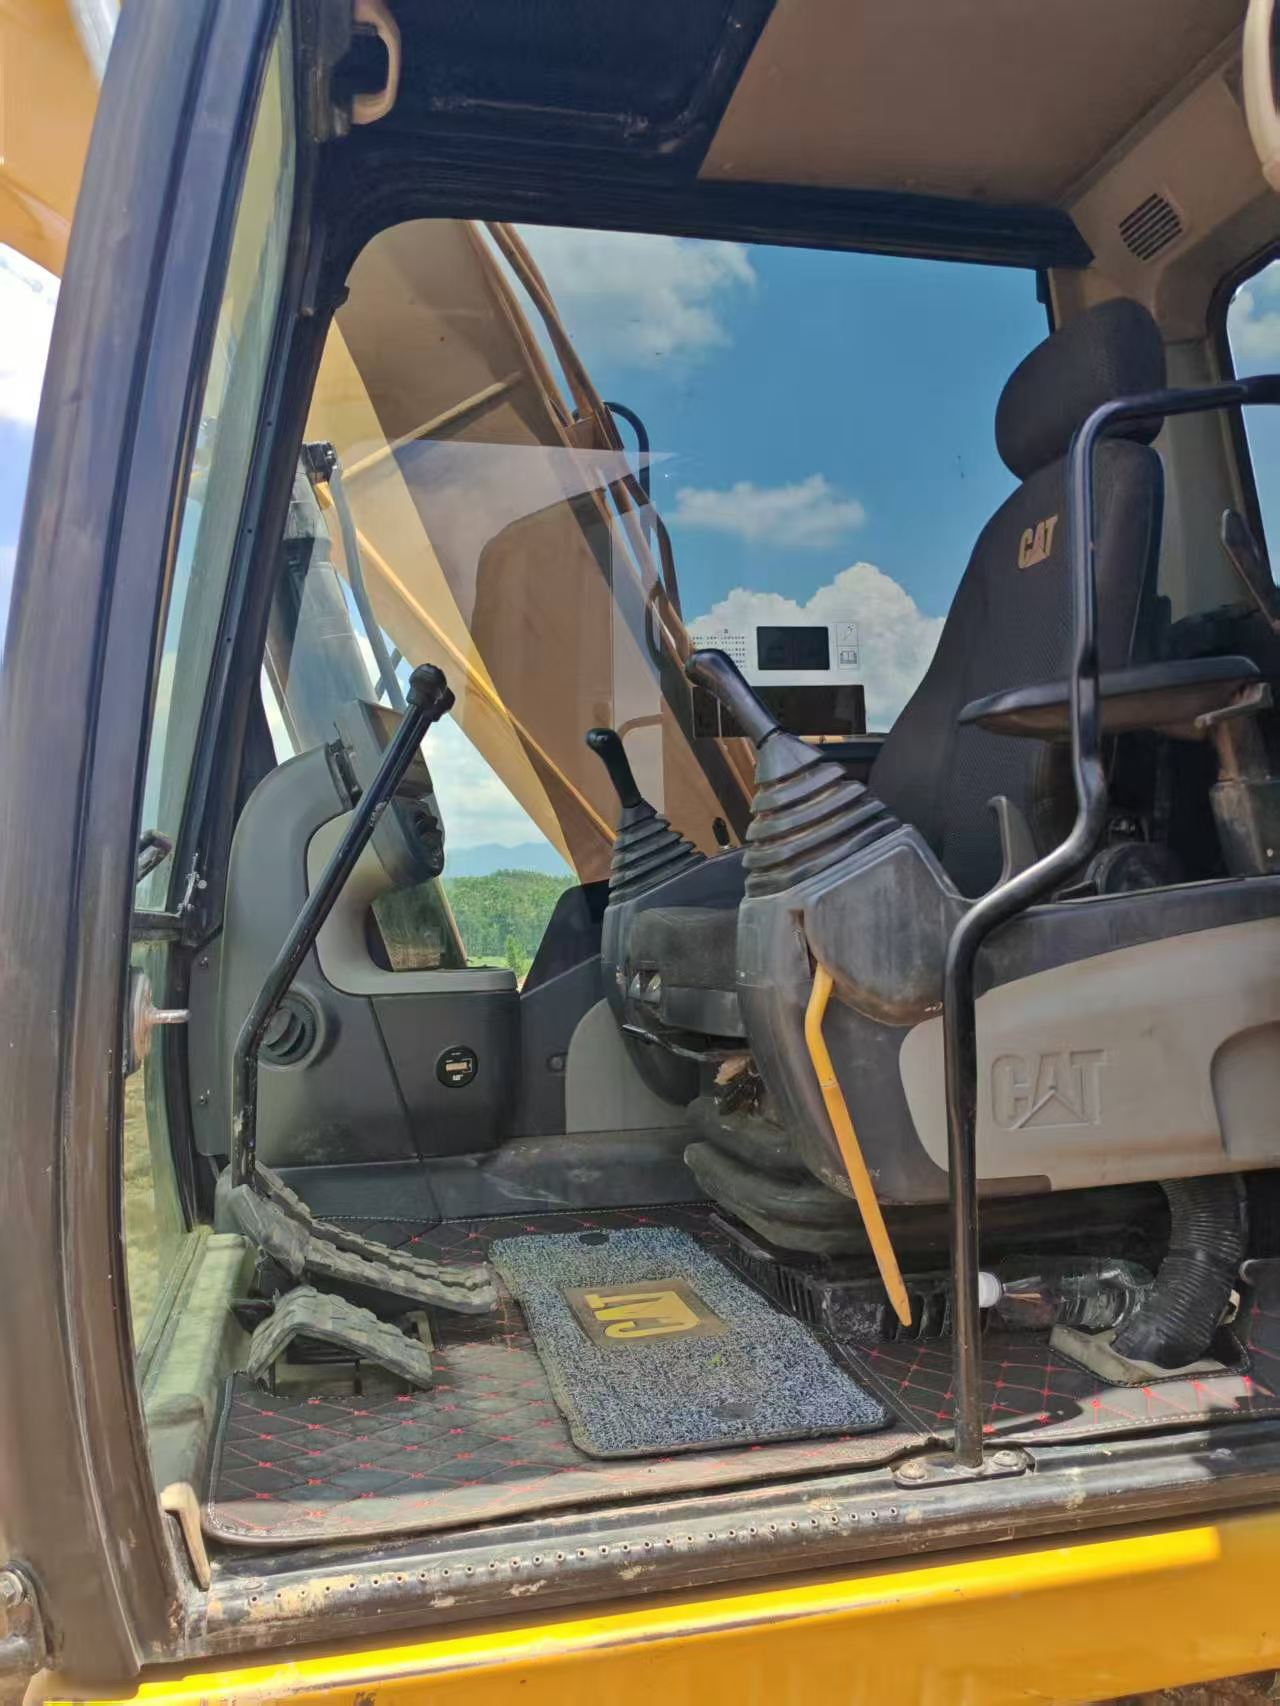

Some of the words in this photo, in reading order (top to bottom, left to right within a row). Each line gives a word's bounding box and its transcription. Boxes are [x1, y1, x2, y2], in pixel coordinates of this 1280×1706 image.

[1018, 514, 1058, 569] CAT
[991, 1049, 1106, 1131] CAT
[584, 1290, 700, 1338] CAT
